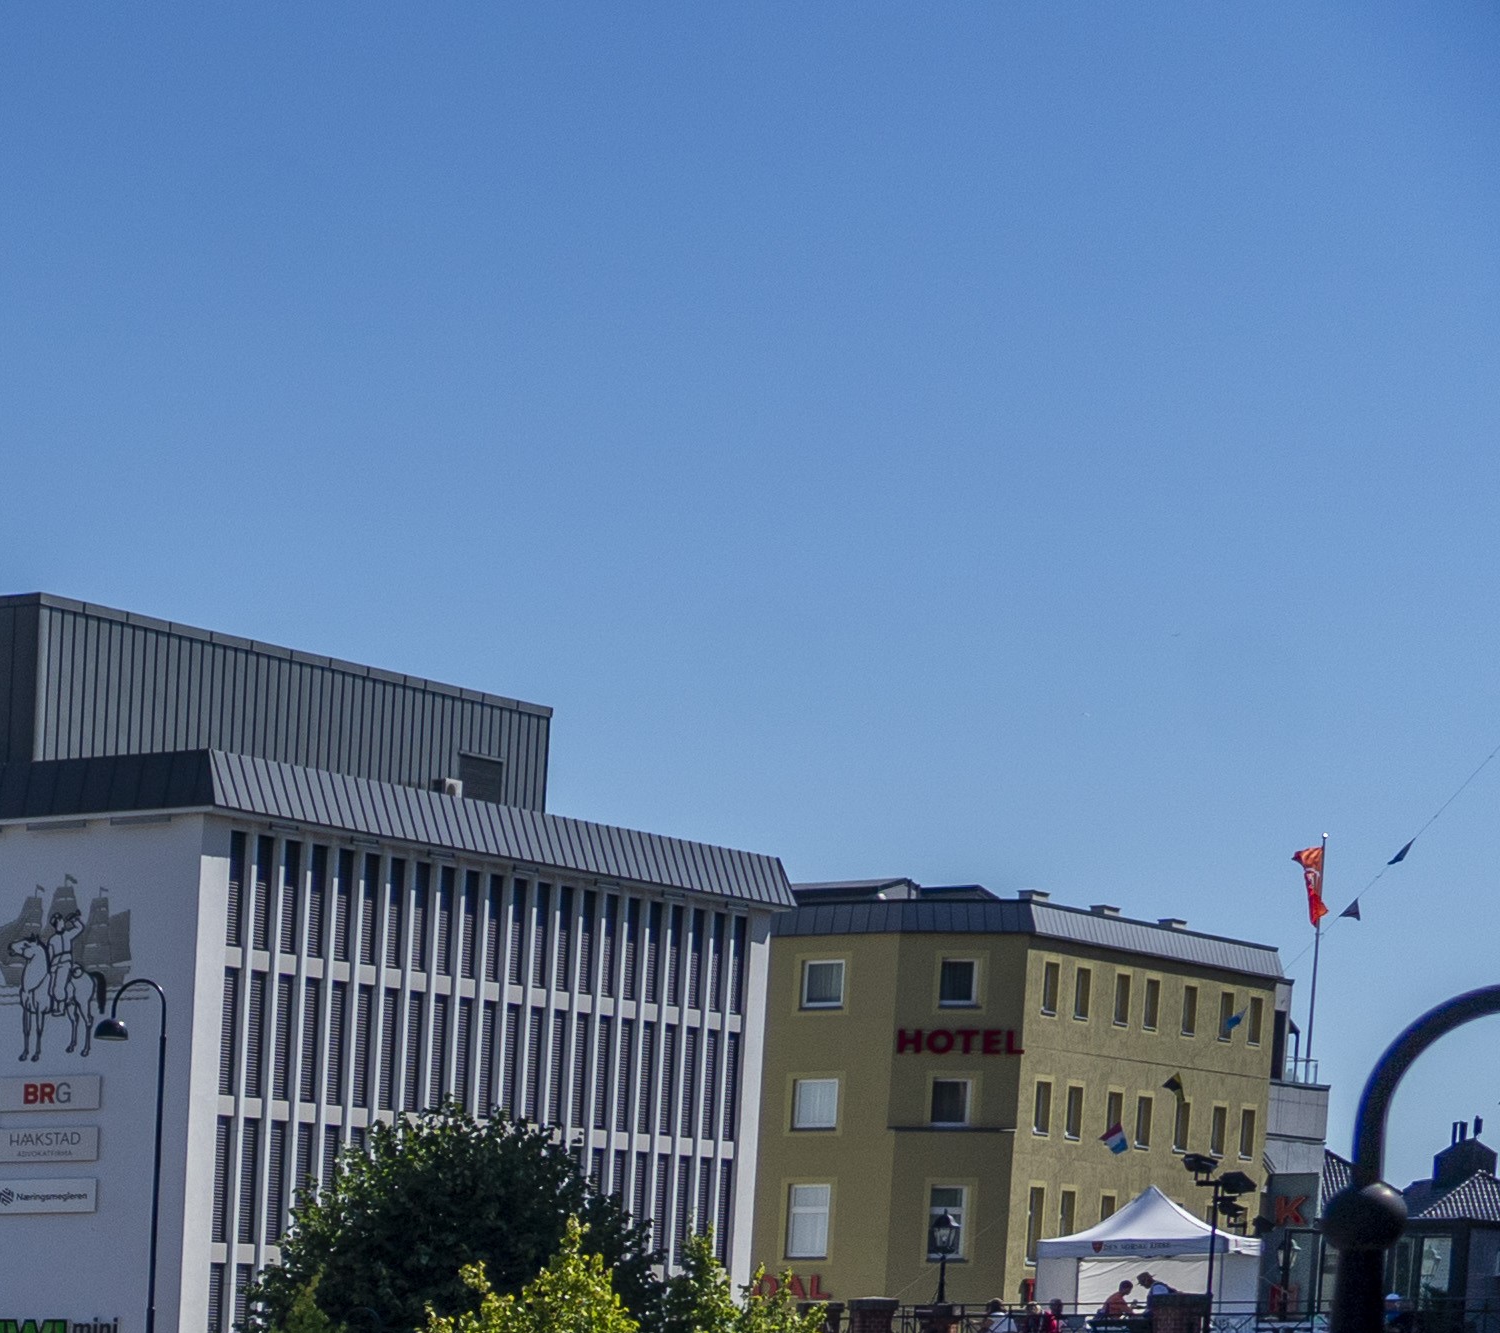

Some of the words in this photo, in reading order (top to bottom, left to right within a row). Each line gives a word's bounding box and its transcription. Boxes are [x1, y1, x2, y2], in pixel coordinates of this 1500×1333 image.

[895, 1029, 1025, 1055] HOTEL
[23, 1082, 72, 1105] BRG
[16, 1191, 88, 1203] Næringsmegleren
